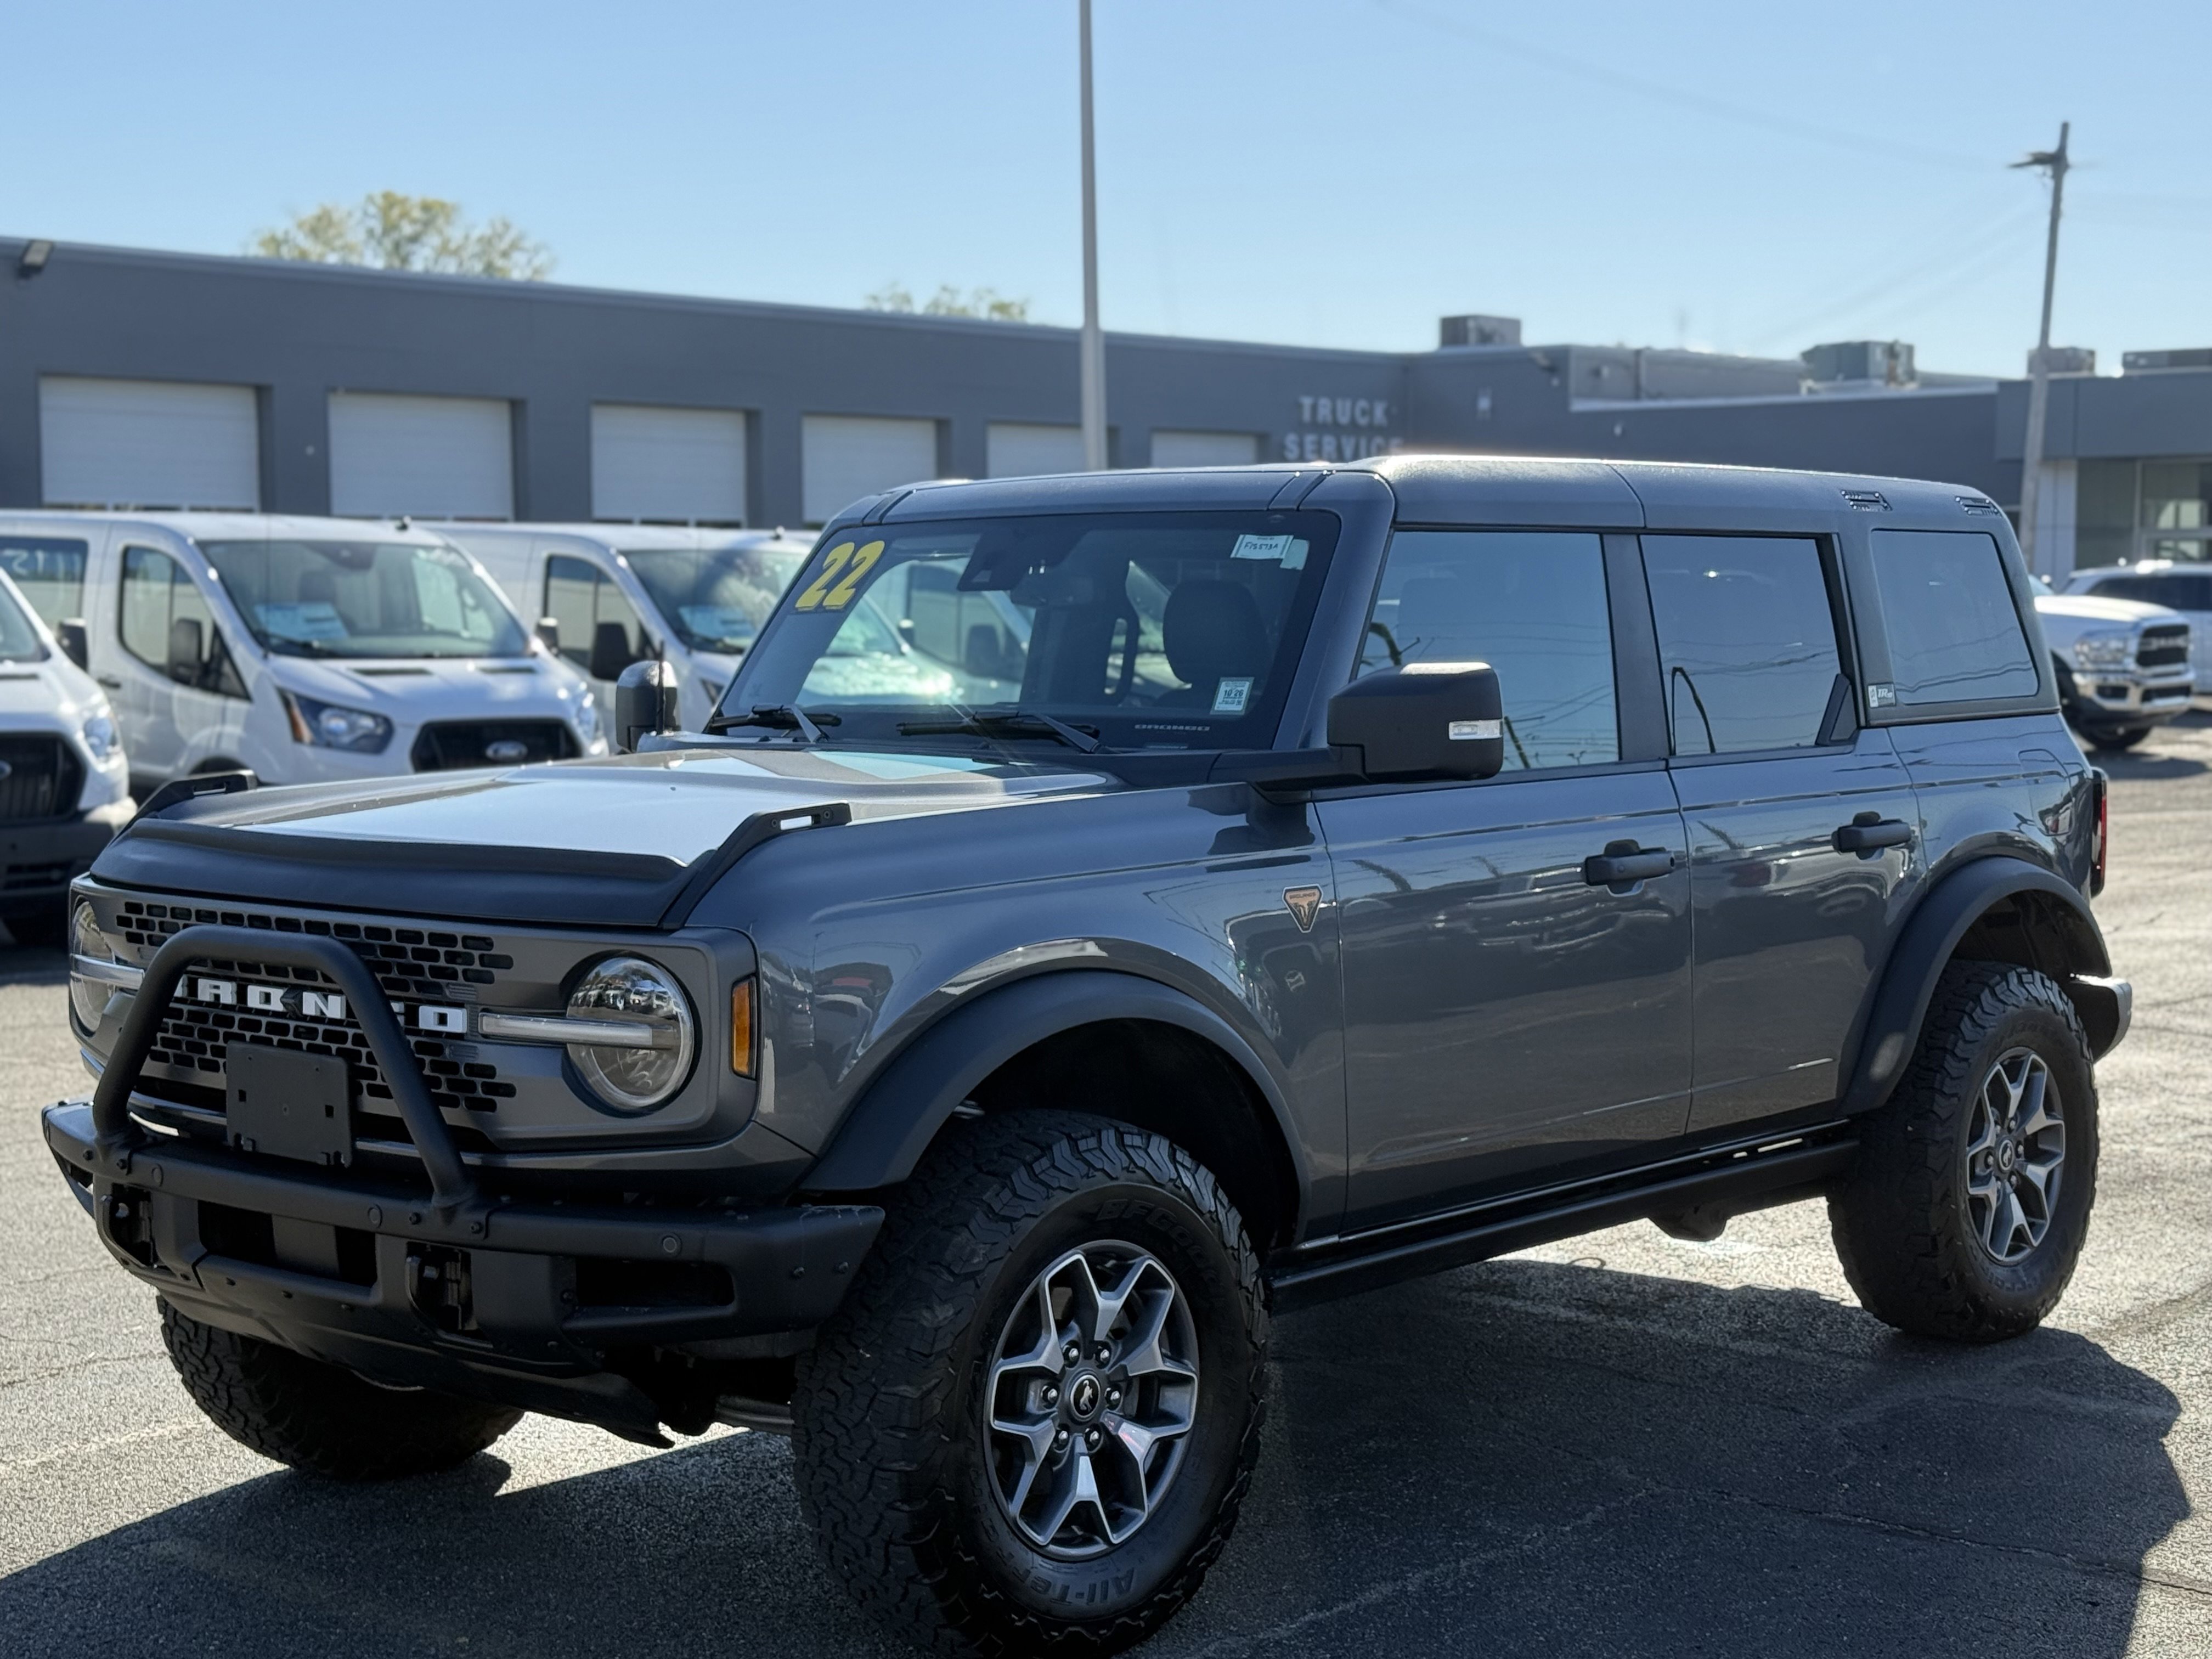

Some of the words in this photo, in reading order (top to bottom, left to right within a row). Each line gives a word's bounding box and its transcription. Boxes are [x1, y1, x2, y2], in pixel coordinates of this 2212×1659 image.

[1299, 396, 1388, 427] TRUCK
[795, 540, 885, 612] 22
[173, 974, 467, 1034] RONO
